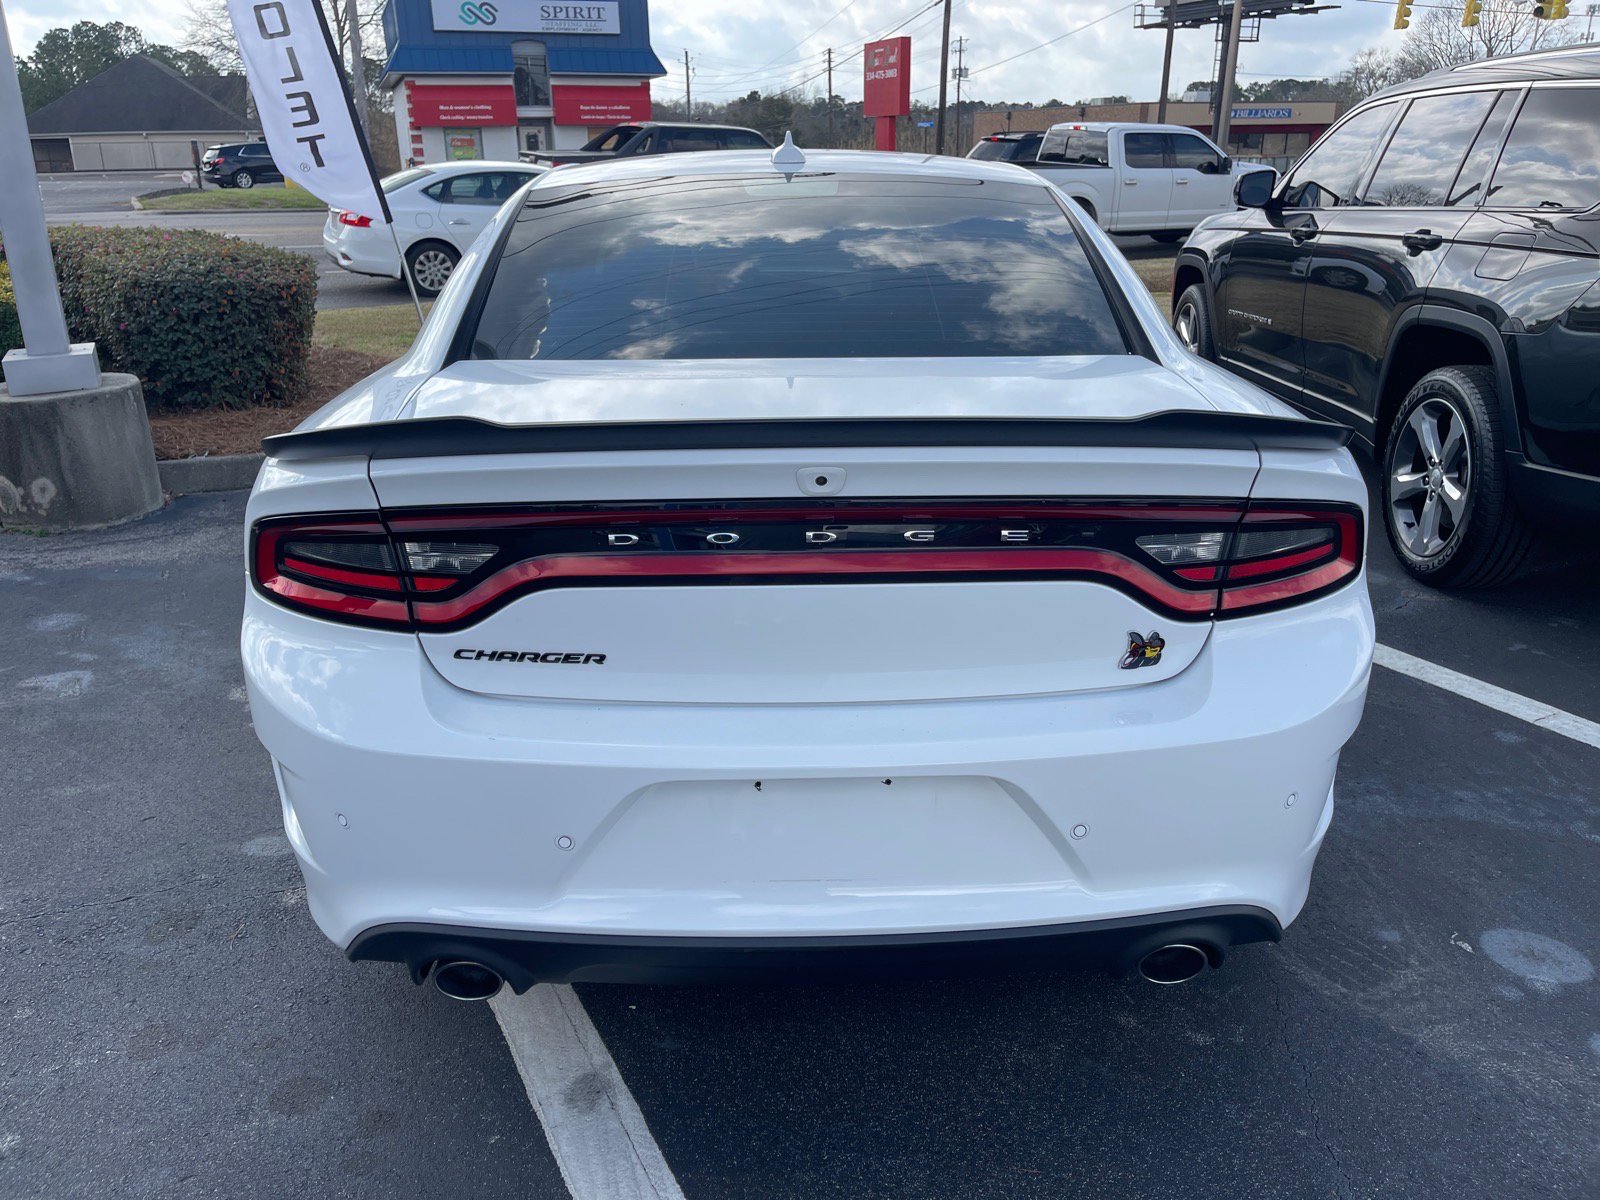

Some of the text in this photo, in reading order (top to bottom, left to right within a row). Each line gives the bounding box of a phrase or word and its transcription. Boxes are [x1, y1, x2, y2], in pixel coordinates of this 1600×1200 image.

[540, 5, 605, 19] SPIRIT
[1236, 109, 1289, 118] BILLIARDS
[608, 529, 1030, 546] DODGE
[453, 649, 607, 665] CHARGER
